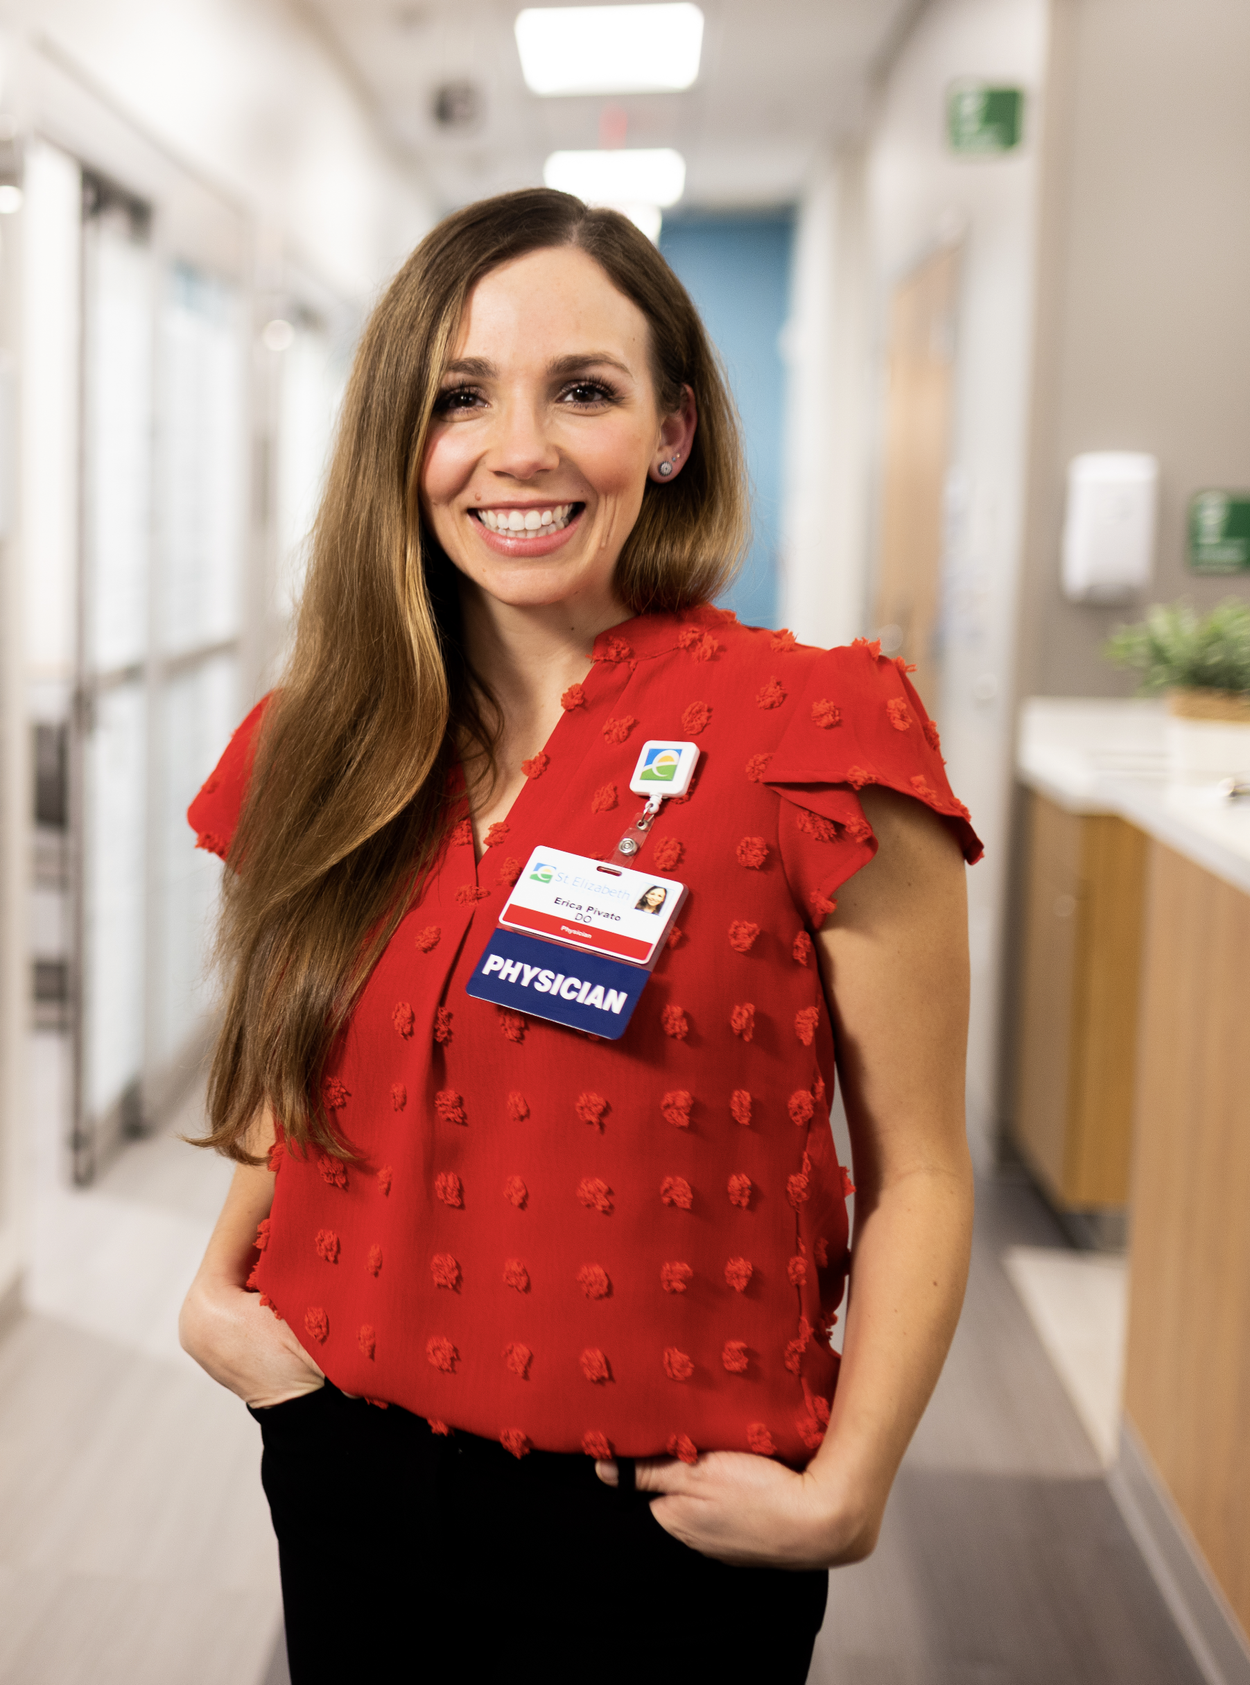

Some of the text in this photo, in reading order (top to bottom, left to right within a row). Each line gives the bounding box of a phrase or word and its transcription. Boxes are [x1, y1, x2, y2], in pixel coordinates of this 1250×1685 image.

[572, 876, 631, 901] Elizabeth
[553, 896, 583, 911] Erica
[586, 905, 622, 922] Pivato
[574, 912, 593, 924] DO
[560, 924, 592, 940] Physician
[481, 953, 629, 1015] PHYSICIAN
